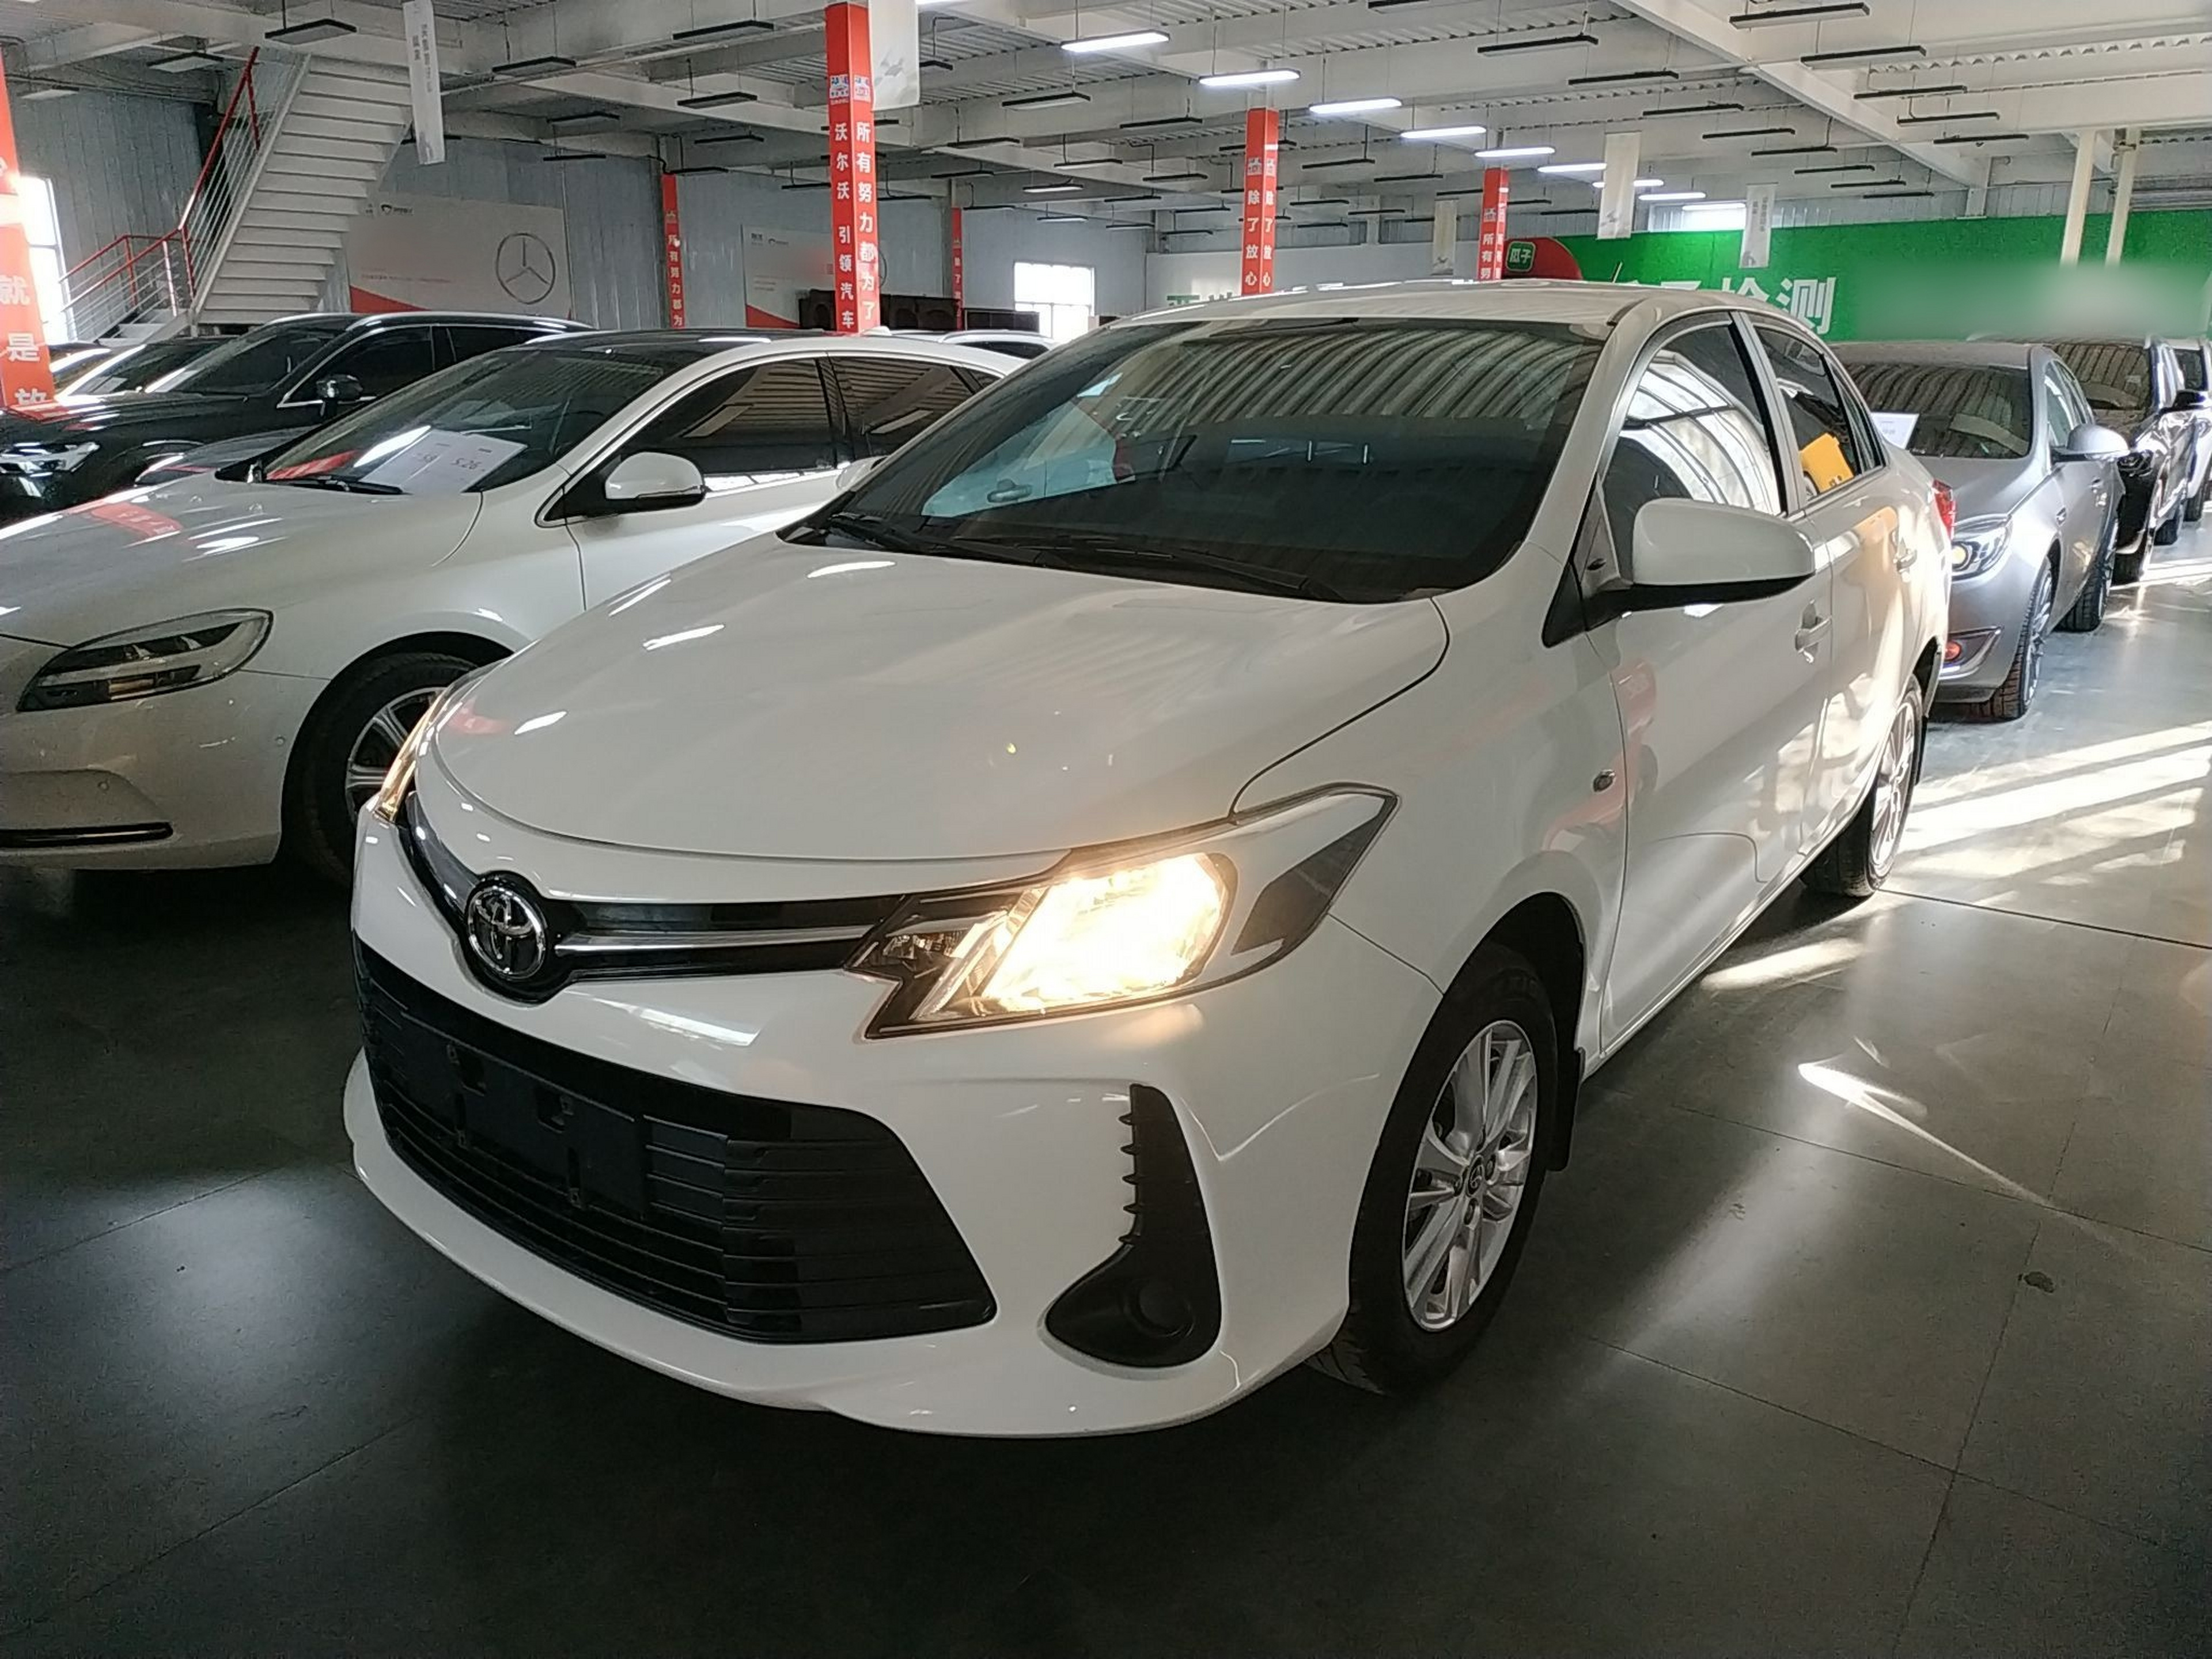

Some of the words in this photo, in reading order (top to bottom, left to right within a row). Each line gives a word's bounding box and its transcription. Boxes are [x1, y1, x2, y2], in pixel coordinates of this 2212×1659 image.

[835, 123, 850, 199] 沃尔沃
[856, 122, 876, 320] 所有努力都为了
[1245, 190, 1260, 286] 除了放心
[1509, 248, 1532, 264] 瓜子
[839, 226, 855, 329] 引领汽车
